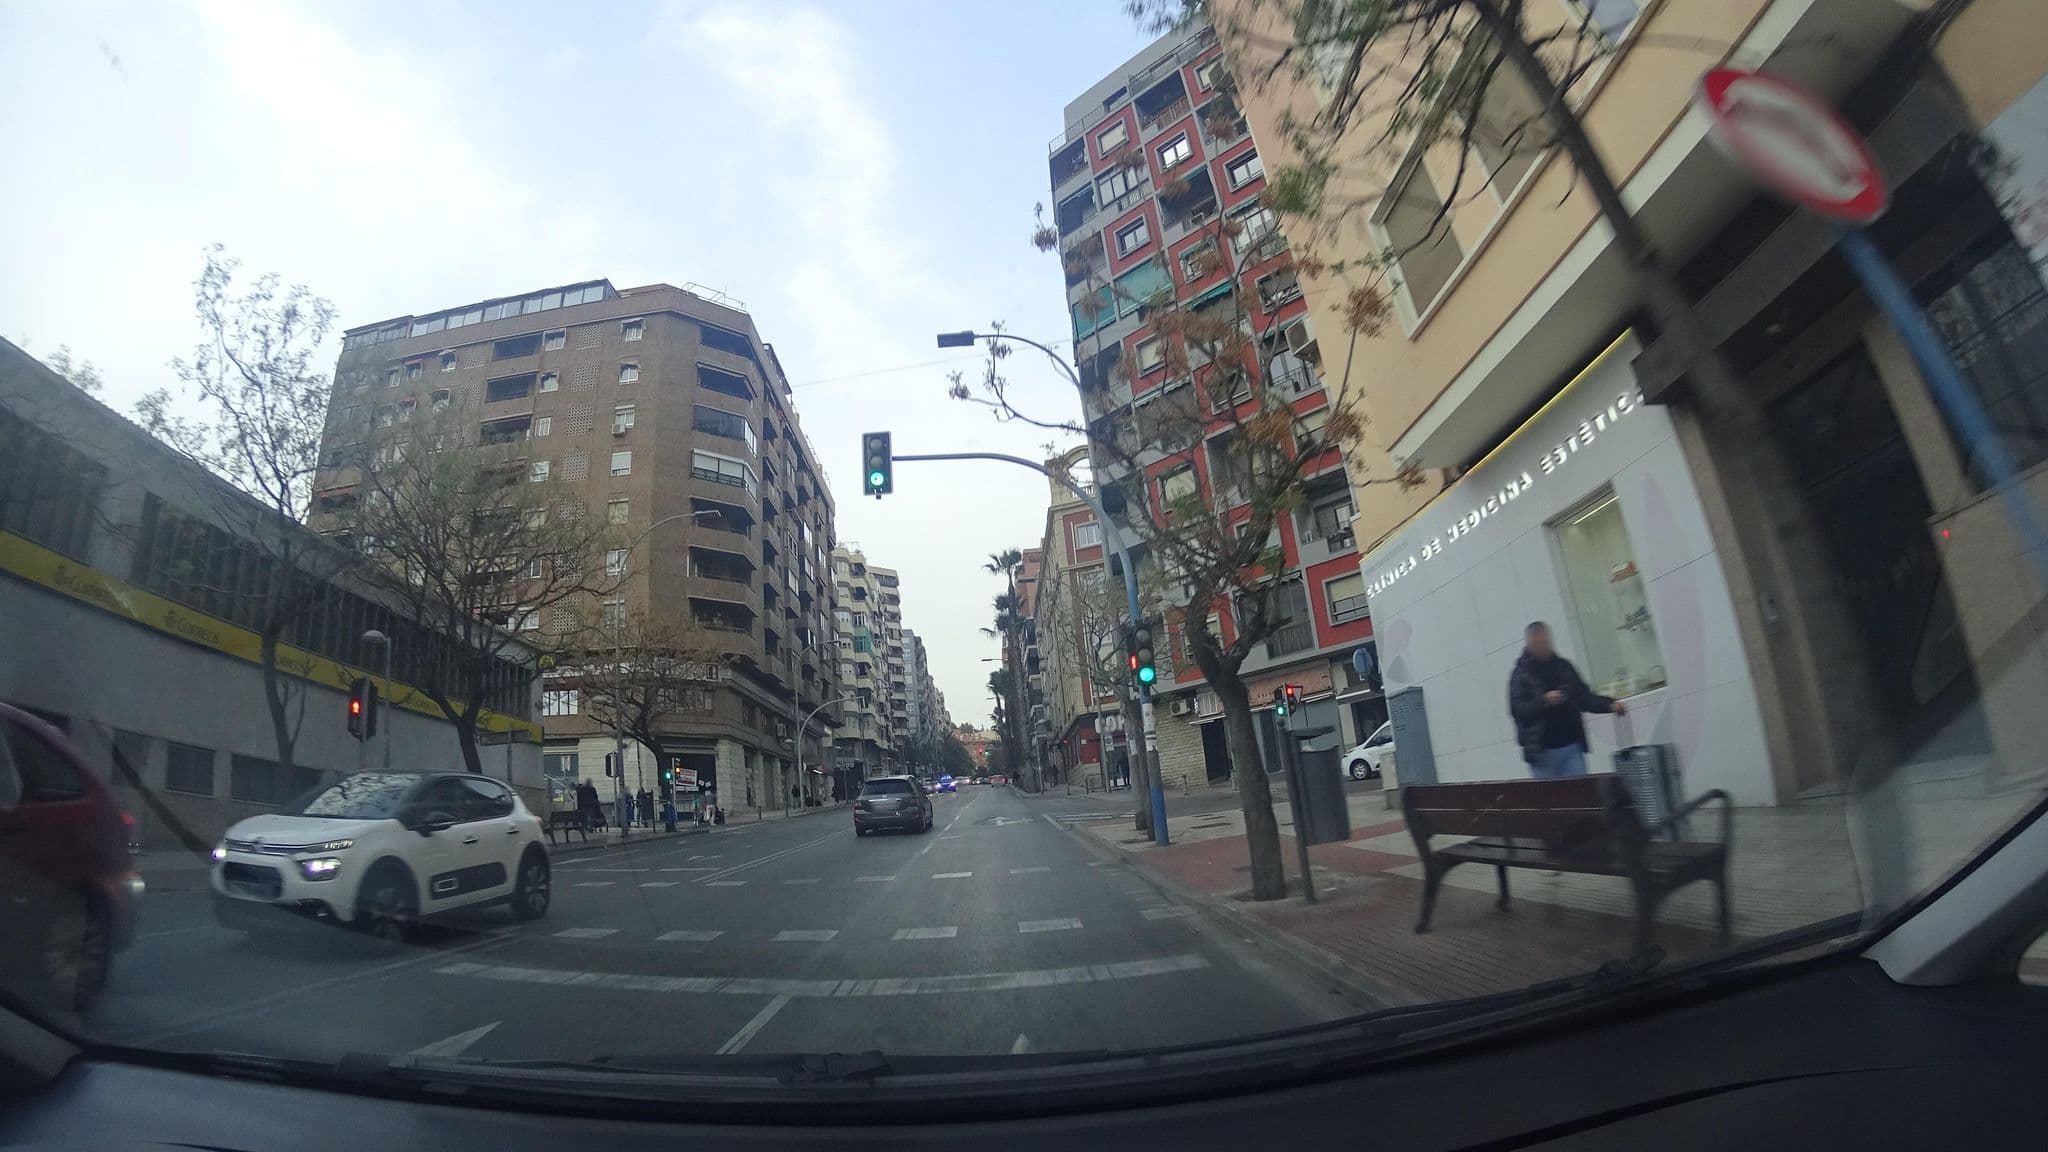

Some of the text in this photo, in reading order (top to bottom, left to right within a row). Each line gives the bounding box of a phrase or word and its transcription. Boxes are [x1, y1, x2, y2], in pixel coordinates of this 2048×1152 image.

[1366, 556, 1416, 598] CLÍNICA
[1421, 537, 1442, 560] DE
[1447, 472, 1533, 543] MEDICINA
